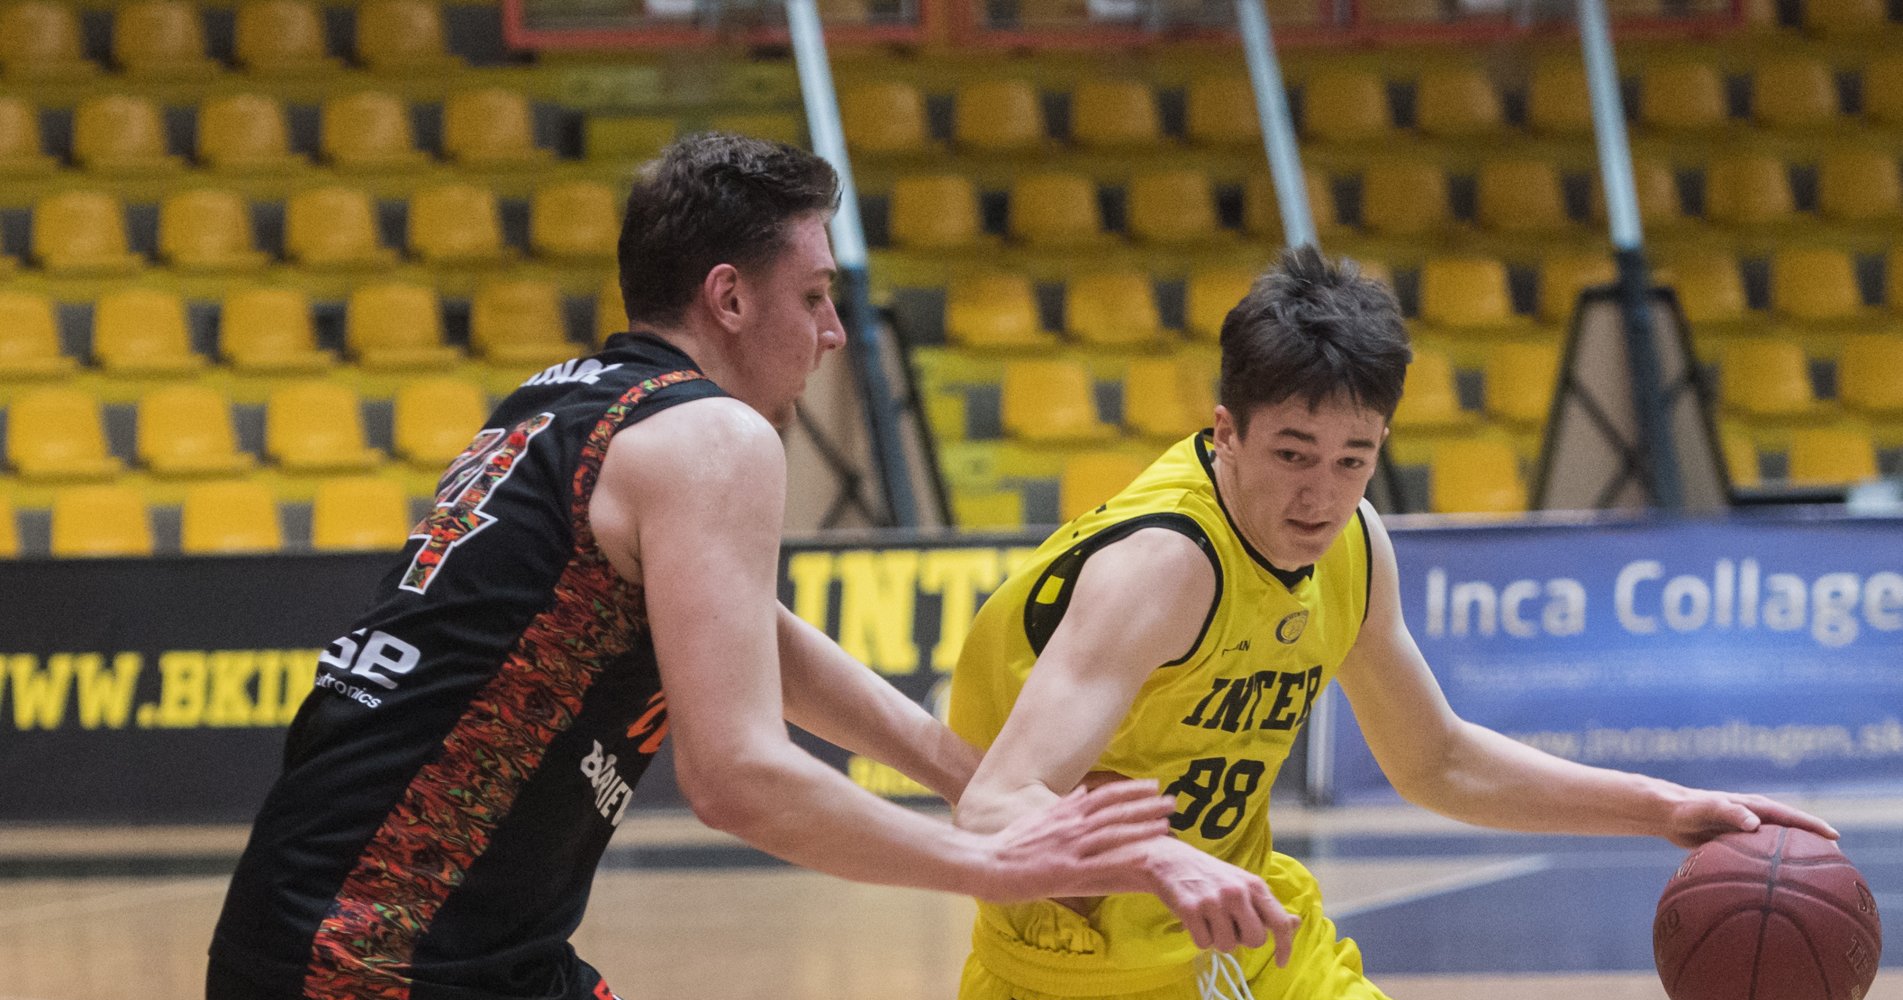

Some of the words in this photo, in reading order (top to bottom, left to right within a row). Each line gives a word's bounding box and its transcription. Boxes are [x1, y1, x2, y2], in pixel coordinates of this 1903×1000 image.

[788, 547, 1033, 674] INT
[1425, 567, 1587, 638] Inca
[1614, 557, 1903, 648] Collage
[1181, 664, 1323, 734] INTER
[1162, 756, 1266, 840] 88
